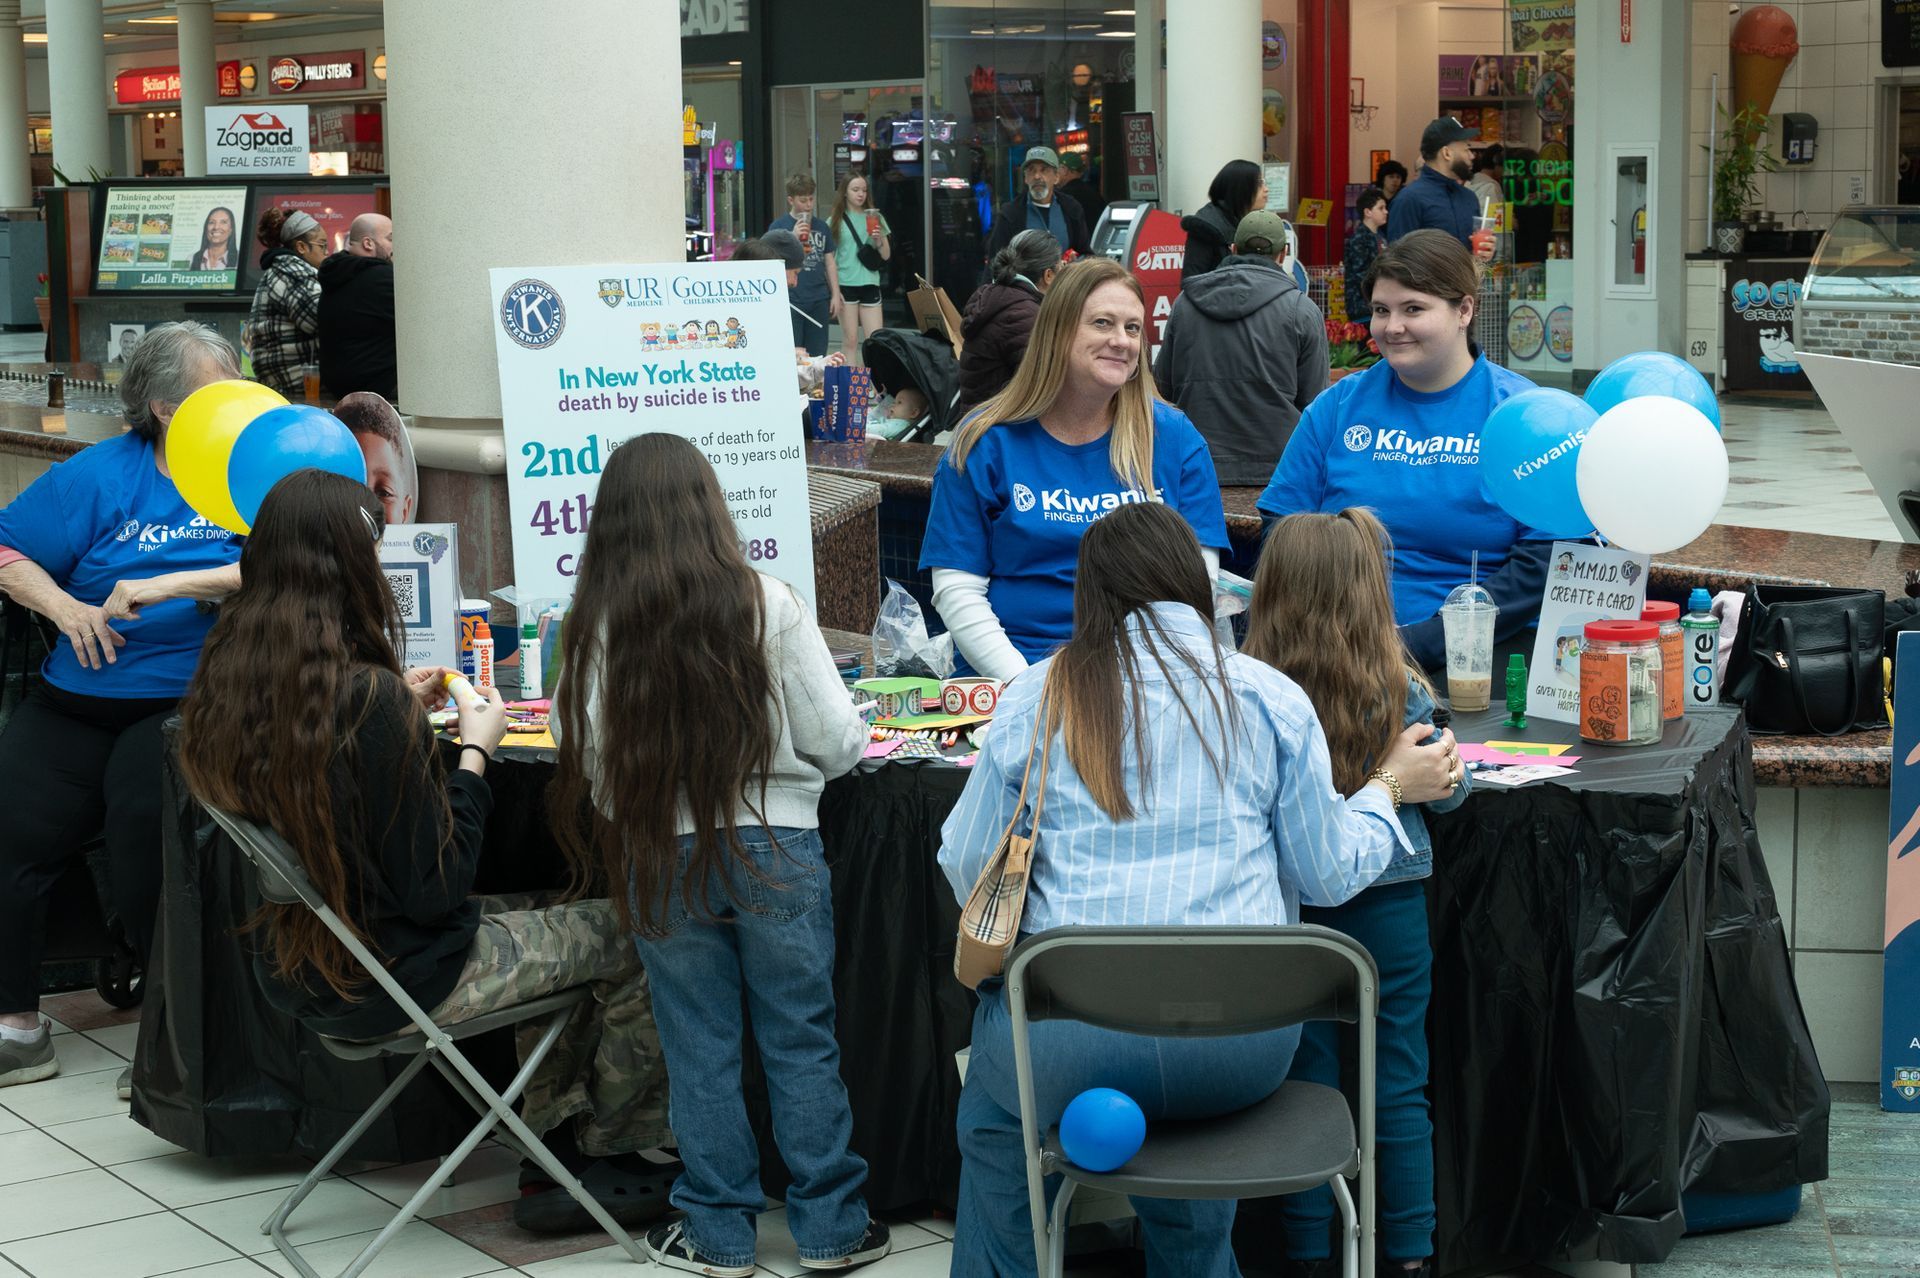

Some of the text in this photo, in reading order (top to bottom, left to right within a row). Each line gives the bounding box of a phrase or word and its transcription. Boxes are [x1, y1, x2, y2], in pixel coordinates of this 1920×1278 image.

[271, 62, 352, 83] CHARLEYS PHILLY STEAKS
[1129, 119, 1147, 131] GET
[217, 128, 293, 150] Zagpad
[1128, 132, 1151, 144] CASH
[1129, 145, 1151, 156] HERE
[220, 156, 296, 167] REAL ESTATE
[116, 193, 152, 202] Thinking
[110, 203, 139, 212] making
[148, 203, 175, 211] move?
[141, 272, 228, 285] Lalla Fitzpatrick
[510, 285, 553, 301] KIWANIS
[625, 276, 777, 300] UR GOLISANO
[683, 297, 727, 305] CHILDREN'S
[728, 296, 763, 304] HOSPITAL
[519, 294, 549, 334] K
[1743, 309, 1794, 321] CREAM
[506, 307, 560, 343] INTERNATIONAL
[1690, 341, 1707, 356] 639
[559, 360, 757, 389] In New York State
[558, 385, 761, 412] death by suicide is the
[701, 432, 714, 446] of
[717, 430, 754, 446] death
[757, 429, 775, 443] for
[522, 434, 602, 478] 2nd
[708, 446, 800, 466] to 19 years old
[1373, 452, 1479, 466] FINGER LAKES DIVISIO
[1513, 428, 1586, 481] Kiwanis
[759, 486, 777, 499] for
[530, 494, 594, 536] 4th
[729, 504, 772, 519] ars old
[1044, 511, 1111, 523] FINGER LAK
[206, 529, 237, 540] DIVIS
[1573, 562, 1619, 583] M.M.O.D.
[1551, 586, 1635, 611] CREATE A CARD
[480, 649, 490, 687] orange
[1693, 633, 1713, 702] core
[1536, 685, 1556, 699] GIVEN
[1558, 688, 1567, 699] TO
[1569, 689, 1574, 699] A
[1557, 701, 1580, 713] HOSPIT
